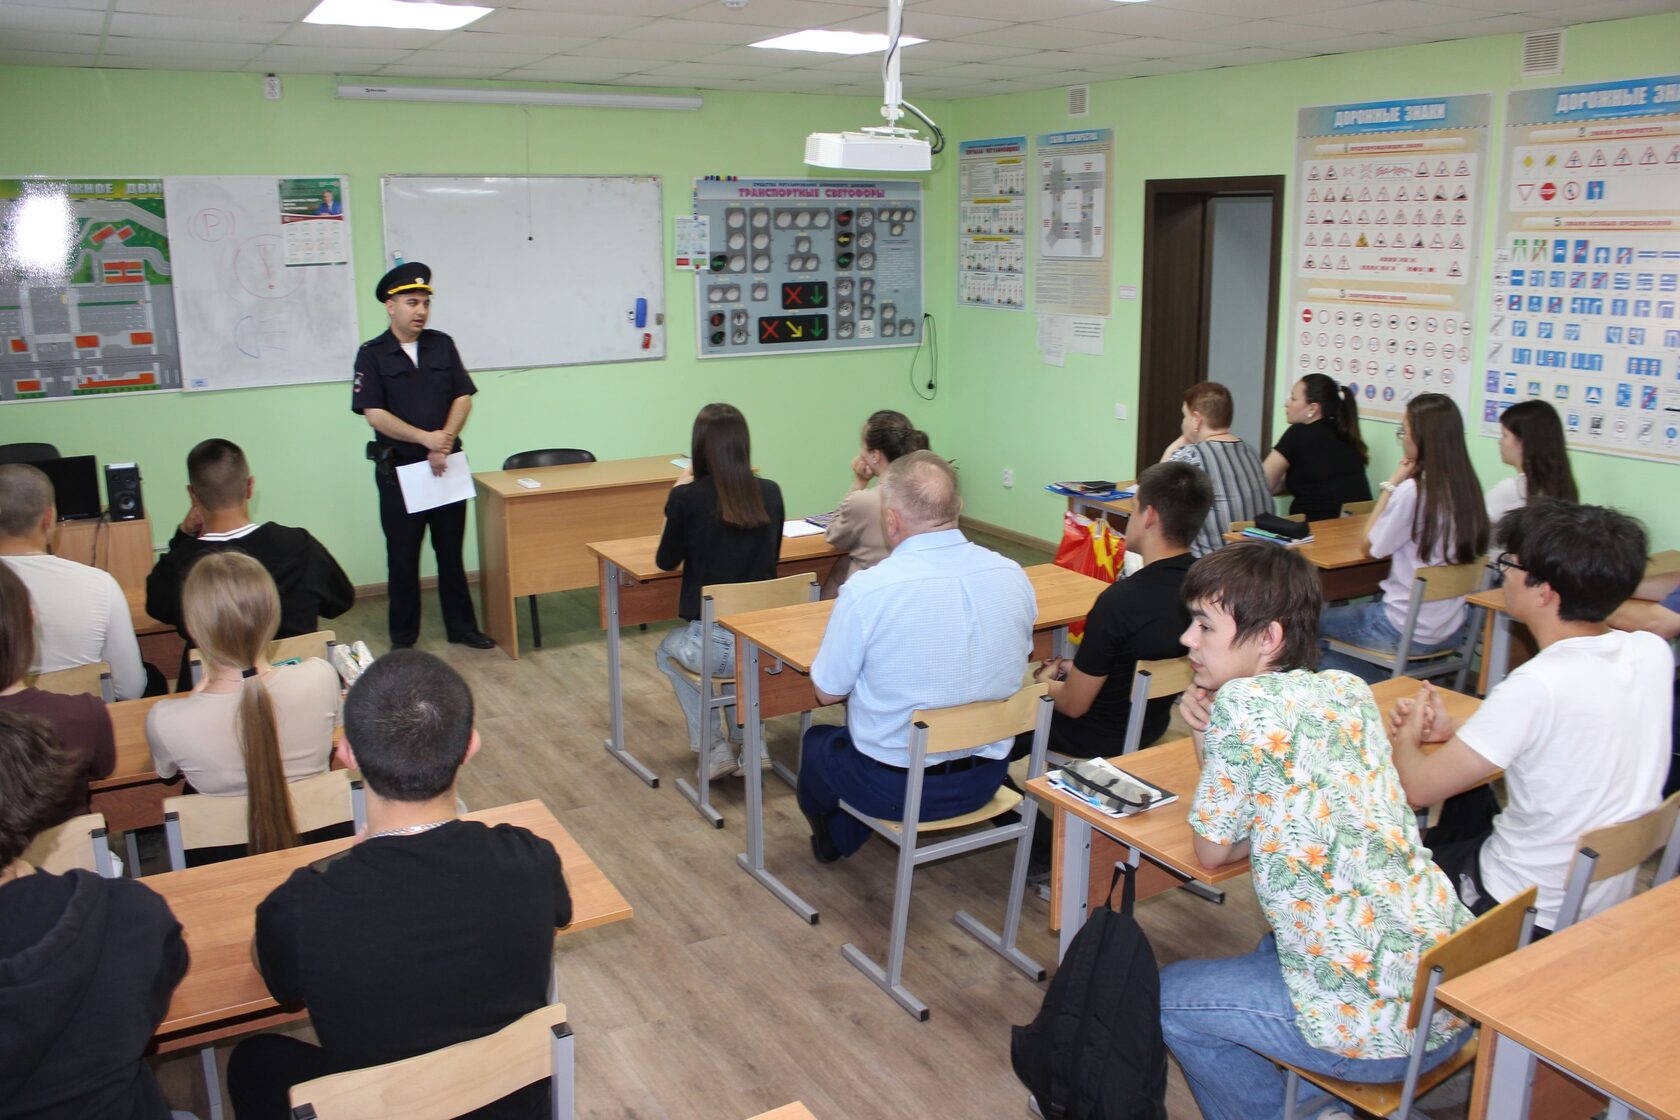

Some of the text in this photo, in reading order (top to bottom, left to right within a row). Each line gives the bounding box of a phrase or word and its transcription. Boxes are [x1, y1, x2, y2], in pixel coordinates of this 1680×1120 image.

[1555, 86, 1648, 114] ДОРОЖНЫЕ
[1334, 103, 1446, 128] ДОРОЖНЫЕ ЗНАКИ
[126, 183, 163, 194] ДВИ
[738, 188, 885, 198] ТРАНСПОРТНЫЕ СВЕТОФОРЫ
